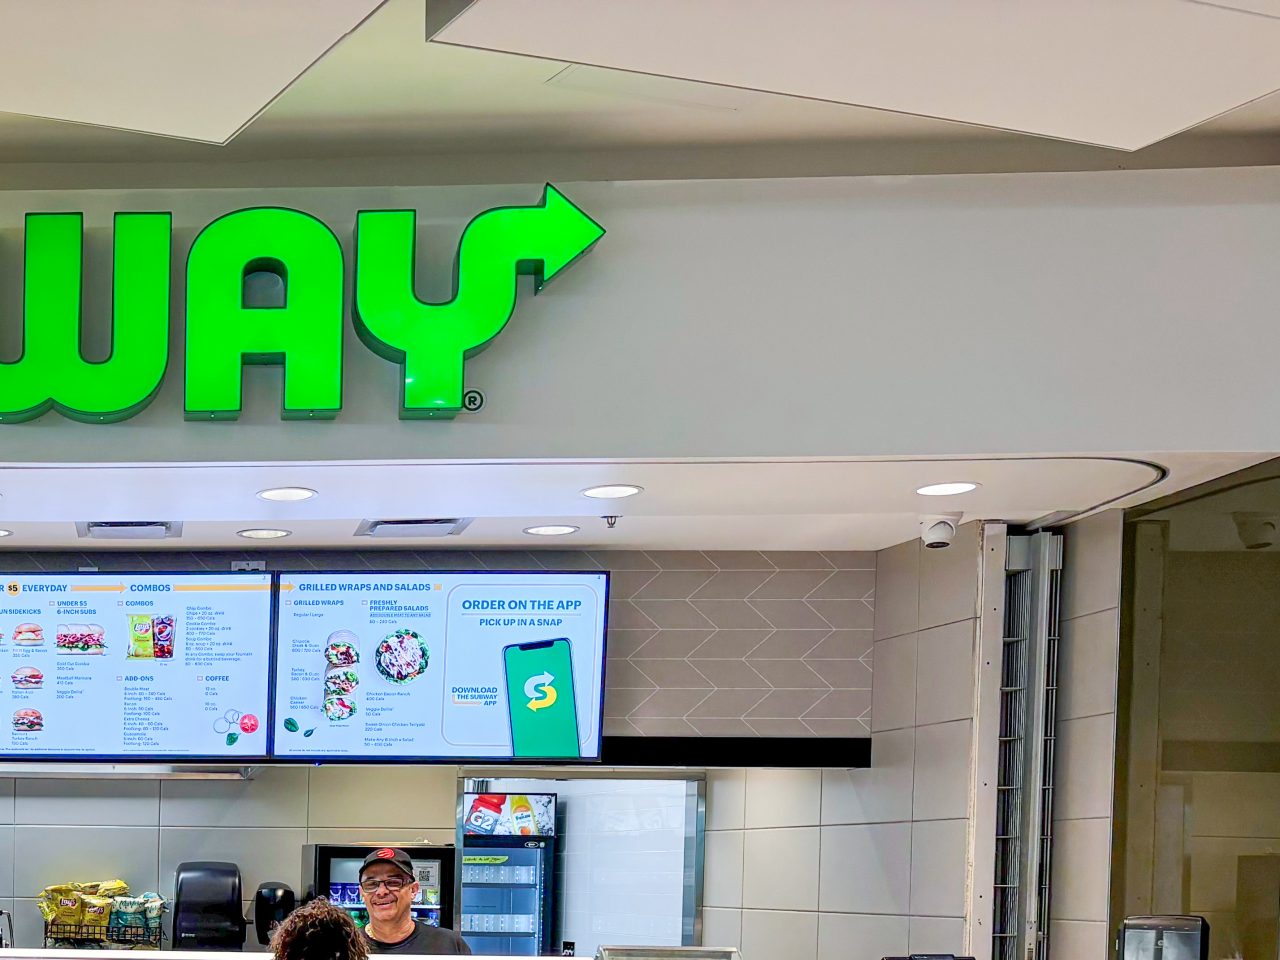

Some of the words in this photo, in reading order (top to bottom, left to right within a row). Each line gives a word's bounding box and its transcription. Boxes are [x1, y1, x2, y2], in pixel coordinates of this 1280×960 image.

[22, 584, 67, 592] EVERYDAY
[130, 584, 171, 592] COMBOS
[462, 600, 505, 610] ORDER
[508, 600, 527, 610] ON
[530, 600, 554, 610] THE
[556, 600, 582, 610] APP
[471, 811, 494, 830] G2
